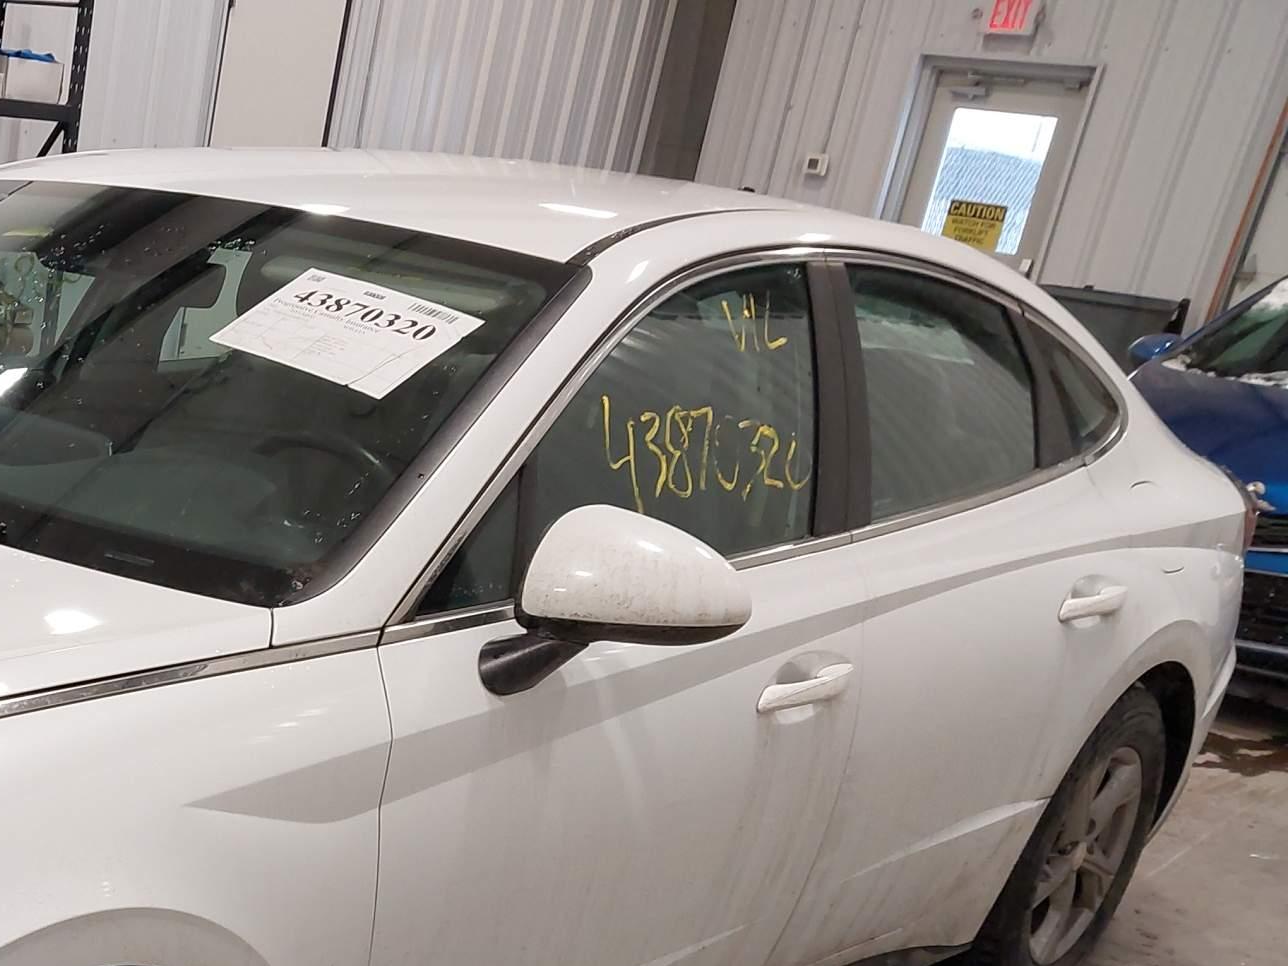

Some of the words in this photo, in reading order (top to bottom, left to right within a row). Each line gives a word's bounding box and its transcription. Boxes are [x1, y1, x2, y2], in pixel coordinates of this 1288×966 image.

[989, 0, 1032, 30] EXIT
[950, 202, 1006, 220] CAUTION
[293, 289, 436, 341] 43870320
